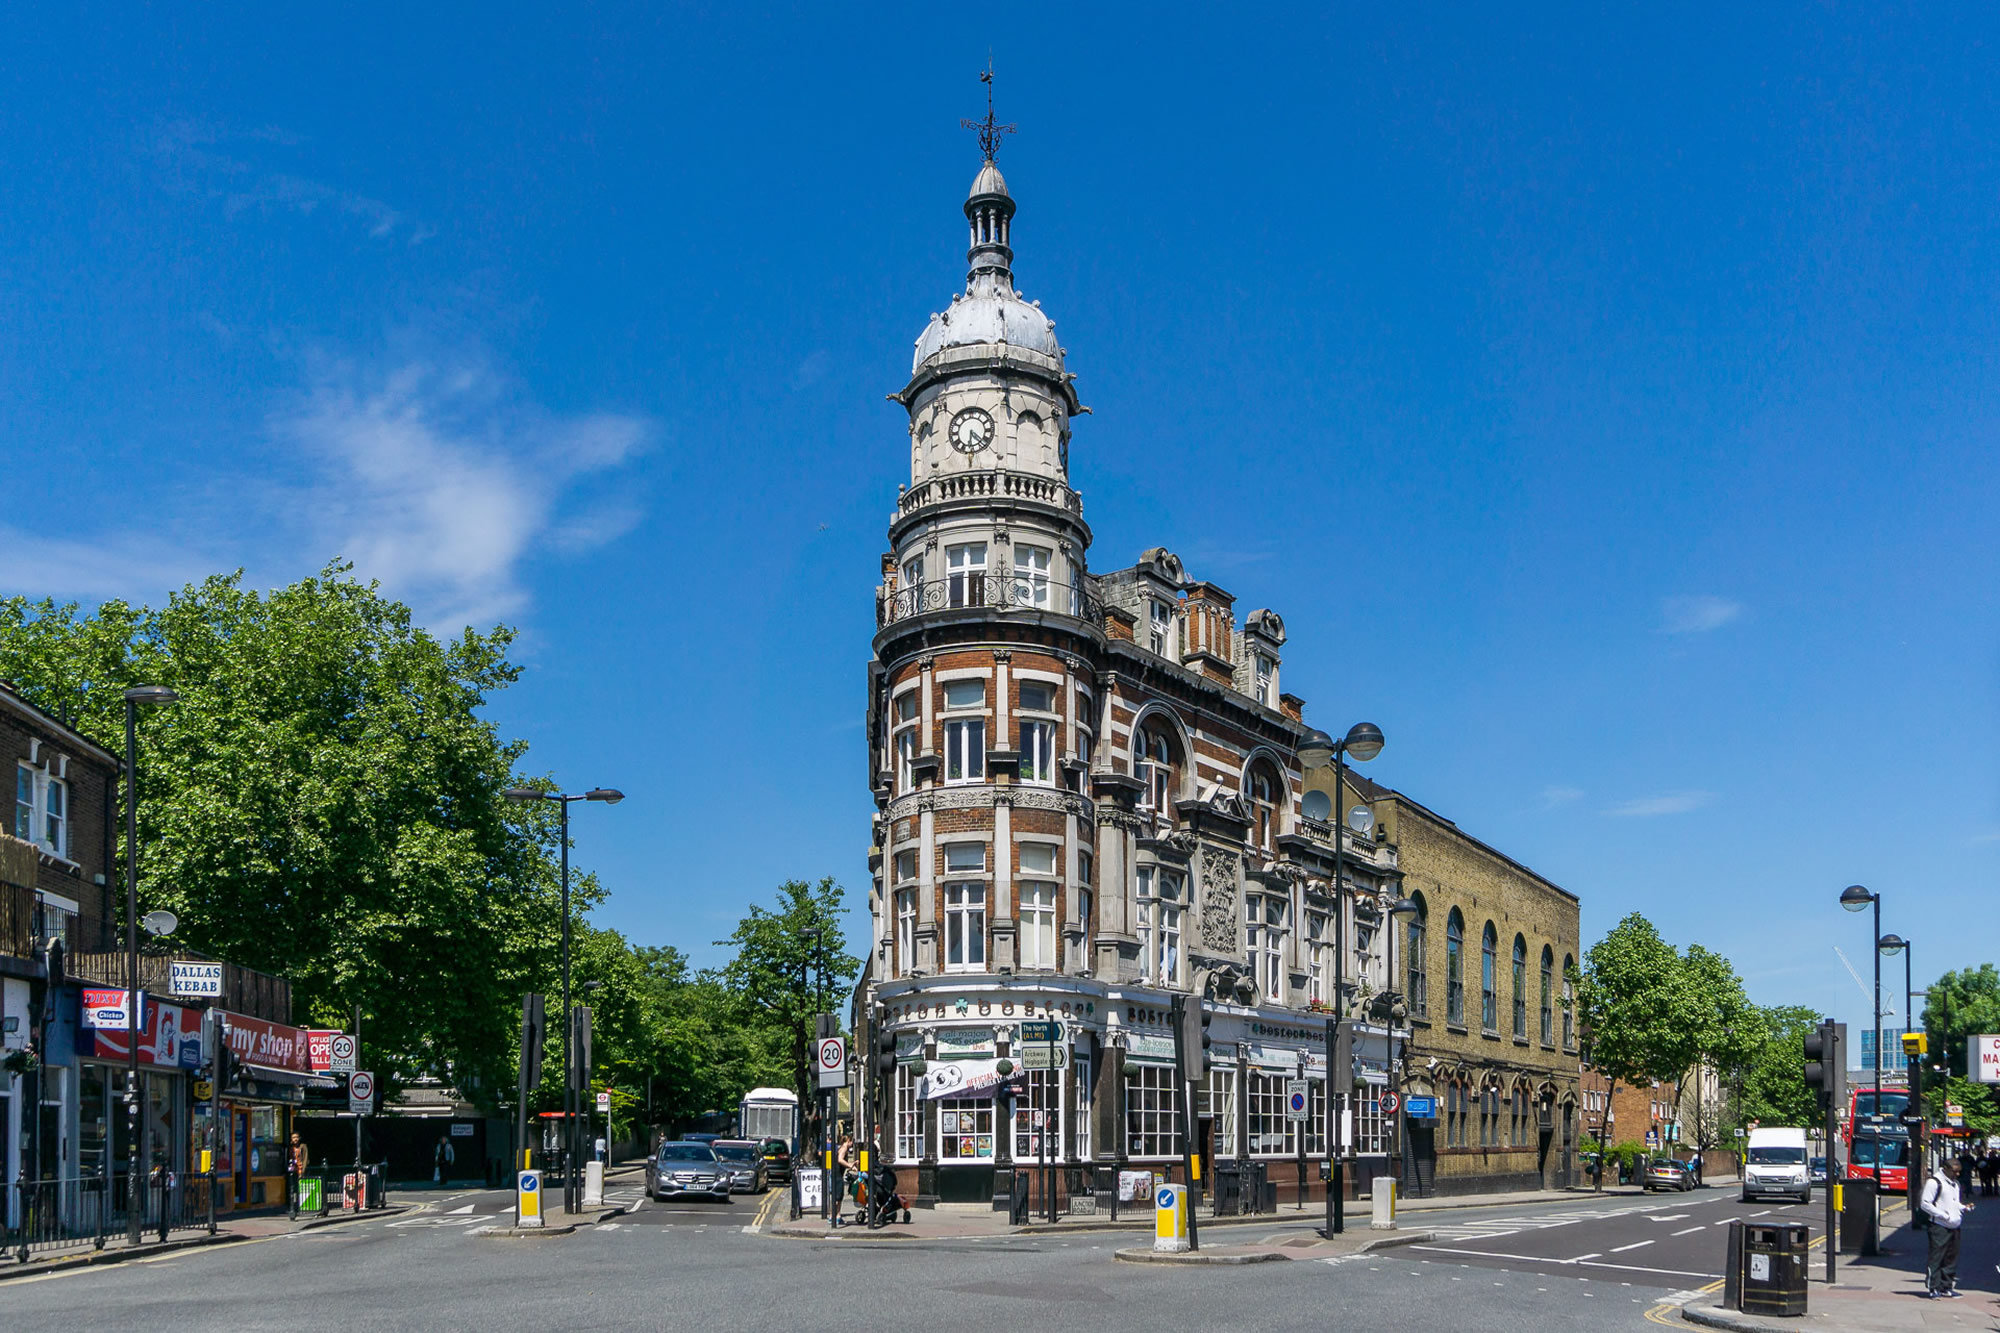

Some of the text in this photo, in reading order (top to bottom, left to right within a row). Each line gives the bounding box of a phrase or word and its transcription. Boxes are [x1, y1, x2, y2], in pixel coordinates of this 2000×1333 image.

[172, 967, 220, 978] DALLAS
[174, 982, 217, 992] KEBAB
[85, 993, 120, 1003] DIXY
[98, 1011, 123, 1020] Chicken
[232, 1026, 293, 1065] my shop
[335, 1042, 351, 1052] 20
[824, 1048, 840, 1060] 20
[1024, 1060, 1048, 1068] Highgate
[1382, 1098, 1397, 1107] 20
